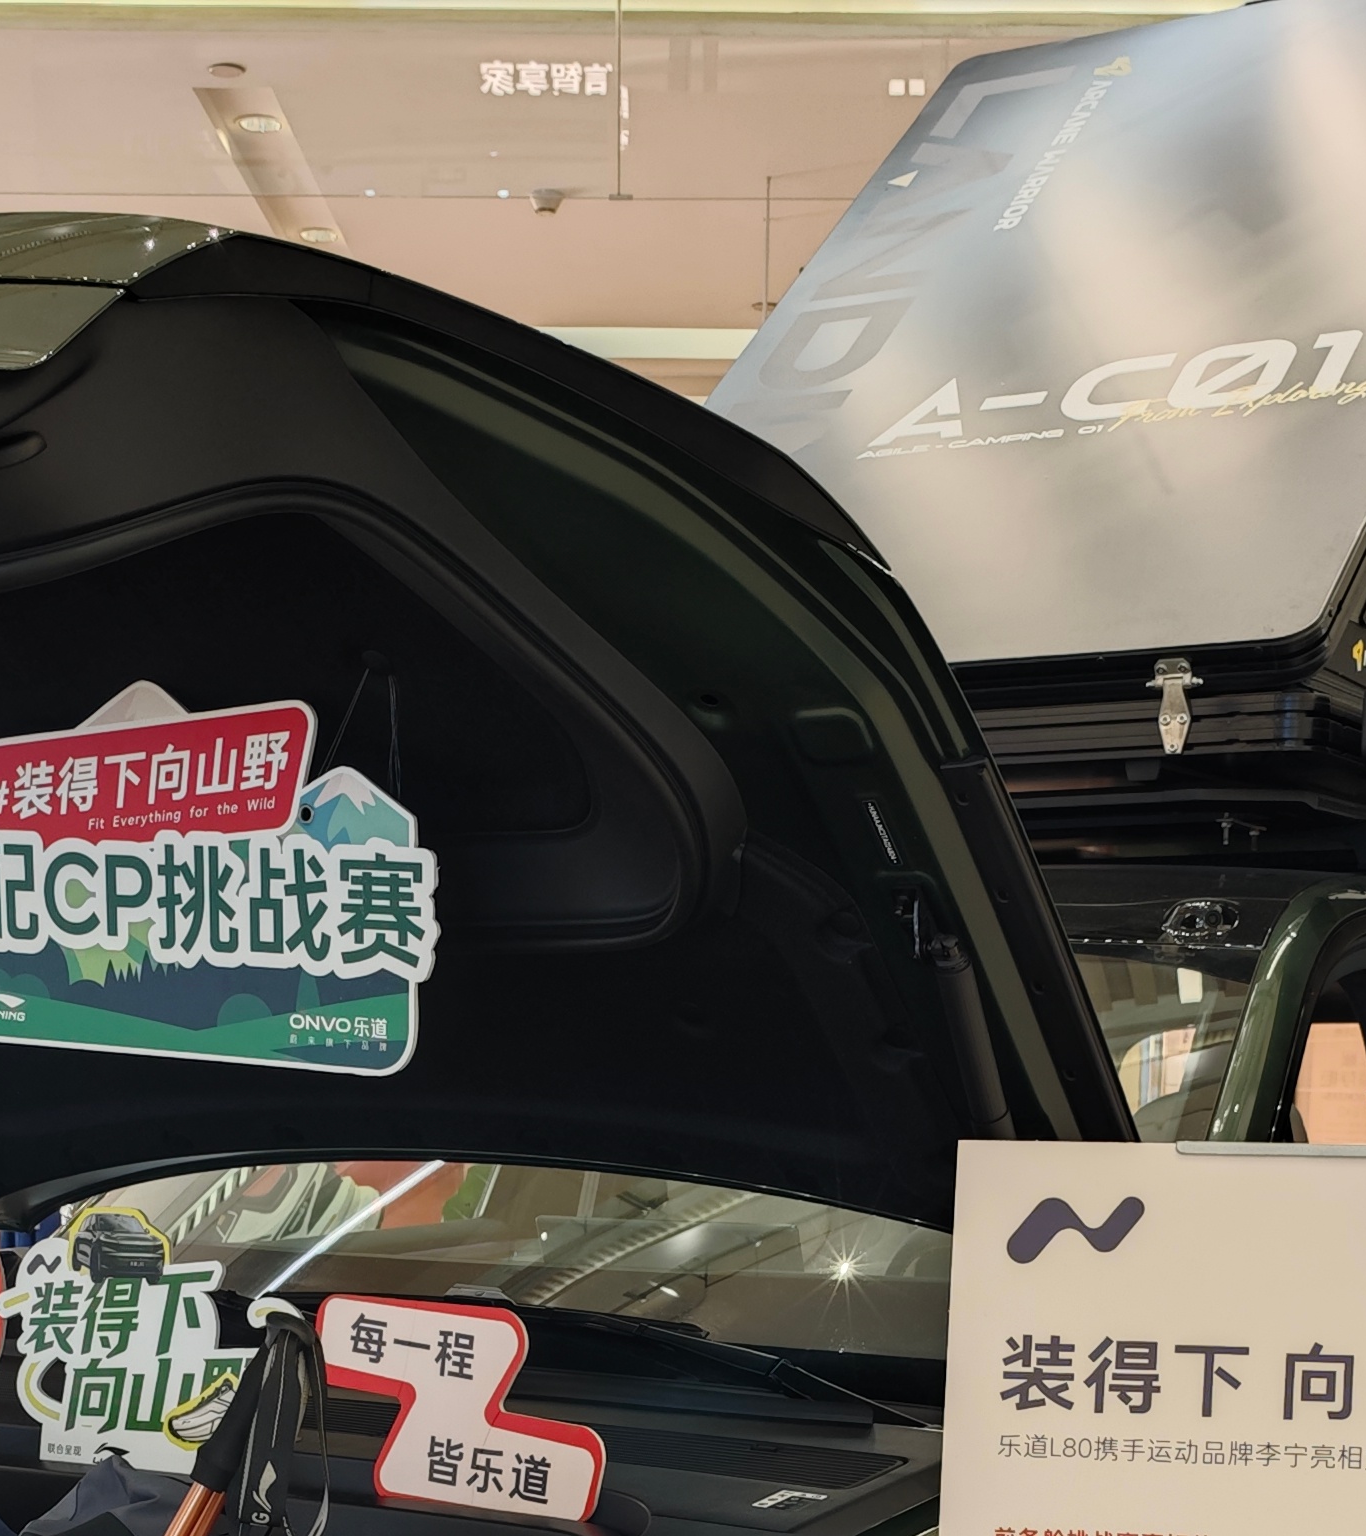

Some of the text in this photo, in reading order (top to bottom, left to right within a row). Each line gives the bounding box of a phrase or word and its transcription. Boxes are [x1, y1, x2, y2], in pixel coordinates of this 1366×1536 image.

[993, 80, 1113, 232] ARCANE WARRIOR
[867, 329, 1364, 447] A-C01
[87, 795, 276, 831] Fit Everything for the Wild
[24, 1268, 216, 1359] 装得下
[349, 1312, 475, 1381] 每一程
[999, 1334, 1250, 1418] 装得下
[47, 1442, 82, 1457] 联合呈现
[427, 1435, 552, 1505] 皆乐道
